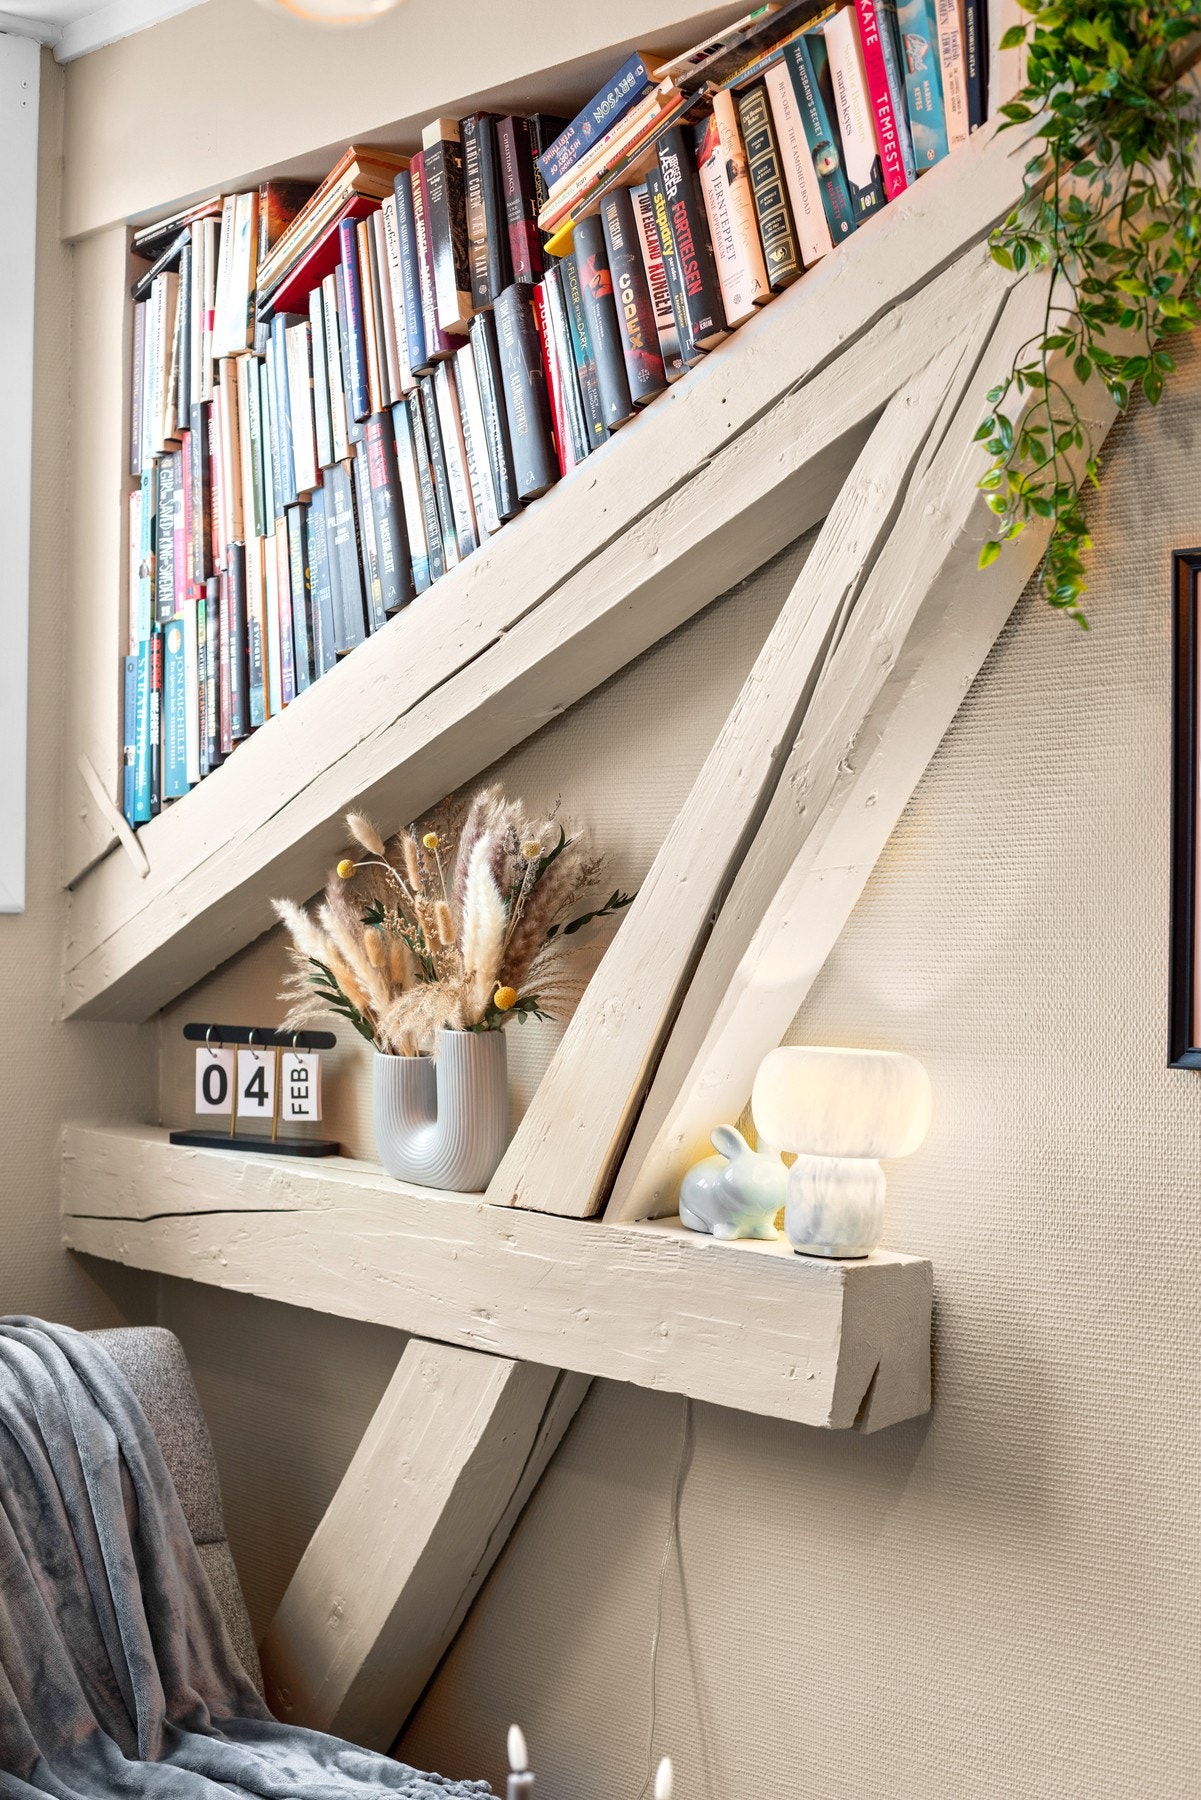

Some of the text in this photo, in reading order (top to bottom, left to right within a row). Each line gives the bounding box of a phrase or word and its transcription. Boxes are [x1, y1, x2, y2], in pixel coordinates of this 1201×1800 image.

[858, 0, 878, 46] KATE
[589, 71, 639, 123] BRYSON
[792, 46, 823, 137] THE HUSBAND'S SECRET
[834, 69, 857, 136] marian keyes
[912, 86, 923, 111] KEYES
[921, 79, 933, 111] MARIAN
[502, 132, 512, 173] CHRISTIAN
[540, 126, 576, 165] EVERYTHING
[547, 138, 582, 175] HISTORY OF
[776, 81, 812, 215] BEN OKRI THE FAMISHED ROAD
[874, 92, 901, 174] TEMPEST
[410, 171, 420, 187] DA
[506, 173, 515, 196] JACQ
[556, 150, 579, 176] A SHORT
[657, 147, 679, 200] JÆGER
[667, 153, 682, 183] JØRGEN
[464, 138, 488, 278] HARLAN COBEN VÆR PÅ VAKT
[711, 173, 737, 261] JERNTEPPET
[825, 180, 841, 220] MORIARTY
[834, 183, 846, 209] LIANE
[603, 201, 624, 251] TOM EGELAND
[641, 214, 662, 260] EGELAND
[651, 181, 678, 281] the stupidity paradox
[669, 200, 704, 296] FORTIELSEN
[706, 188, 726, 260] ANNE APPLEBAUM
[395, 184, 417, 335] RAYMOND KHOURY RINGEN ER SLUTTET
[497, 299, 514, 348] TOM EGELAND
[565, 266, 580, 304] FLICKER
[576, 322, 588, 350] DARK
[616, 272, 644, 351] CODEX
[425, 396, 438, 438] Celeste
[508, 370, 528, 436] LASARUSEFFEKTEN
[585, 379, 597, 419] WILLINGHAM
[591, 387, 599, 407] STACY
[429, 439, 442, 459] Ng
[421, 483, 433, 500] SOM
[437, 482, 448, 514] branner
[481, 472, 491, 501] MY STORY
[158, 469, 173, 601] GIRL SAVED KING SWEDEN
[424, 500, 439, 537] FORTJENER
[289, 528, 303, 595] SANATORIUM
[306, 537, 320, 596] Griffiths
[378, 517, 394, 575] PANSERHJERTE
[280, 614, 289, 636] The
[136, 657, 147, 720] SARAH
[174, 654, 185, 764] JON MICHELET
[201, 1063, 270, 1107] 0 4
[288, 1066, 311, 1115] FEB
